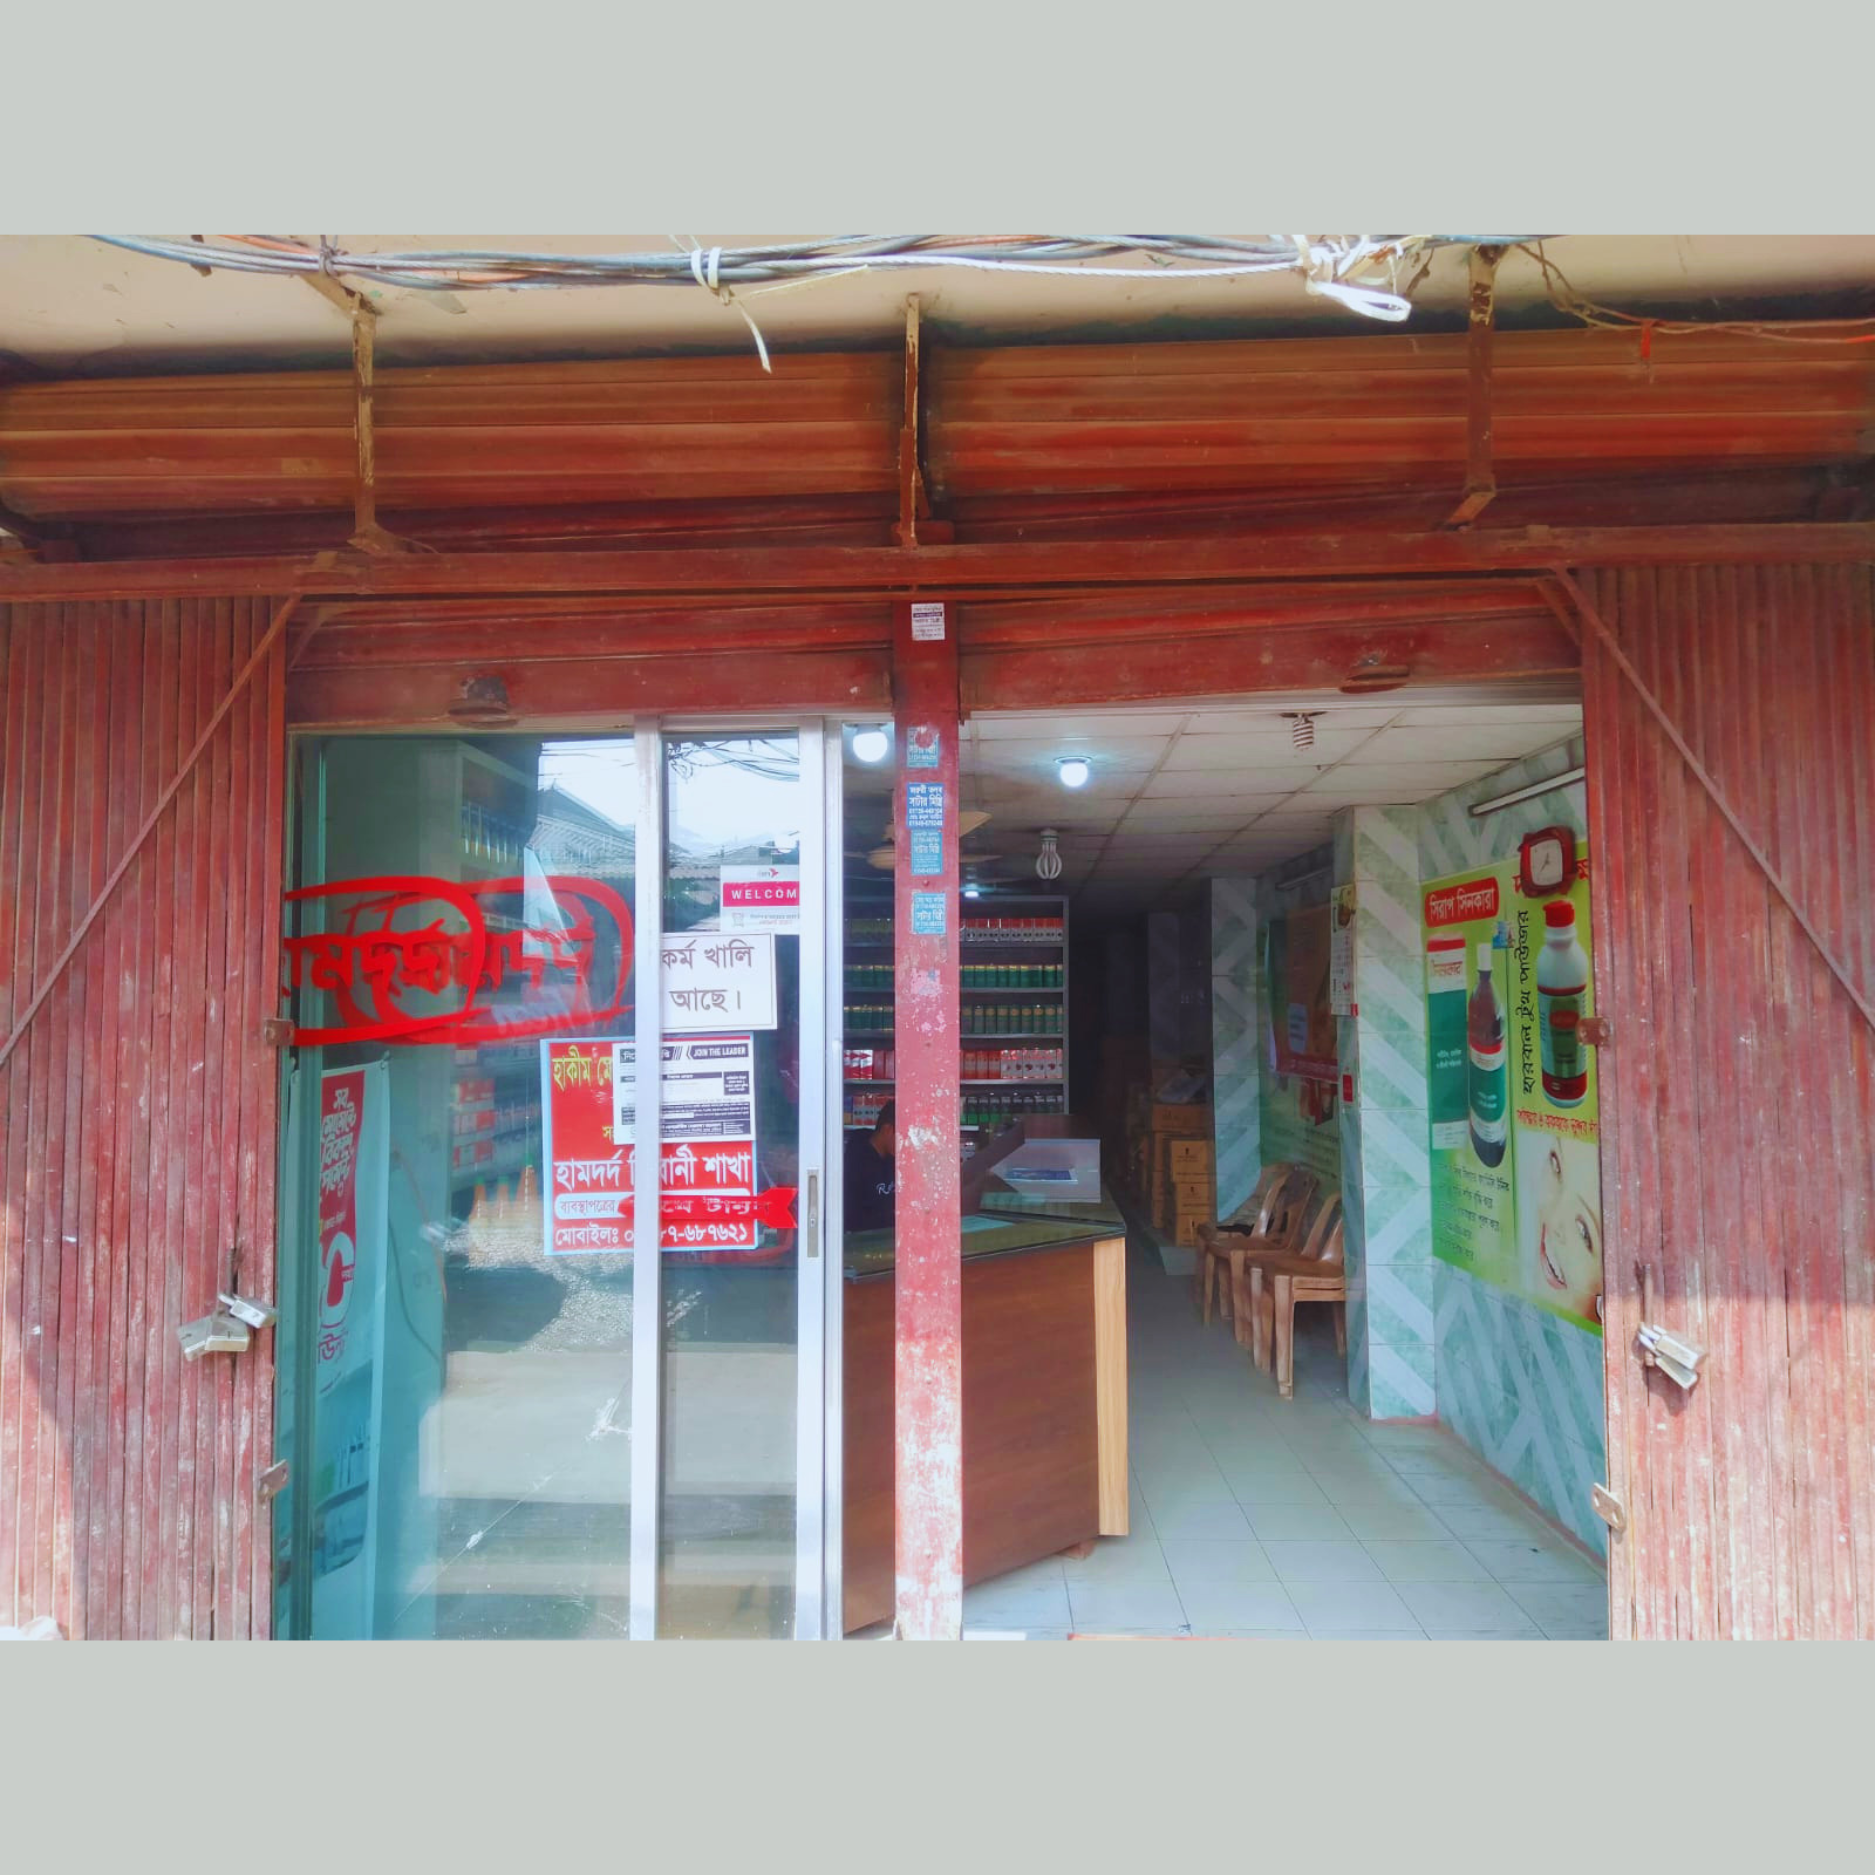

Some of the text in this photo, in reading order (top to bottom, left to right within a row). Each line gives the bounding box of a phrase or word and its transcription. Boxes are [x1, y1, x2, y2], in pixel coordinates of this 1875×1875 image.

[731, 888, 797, 900] WELCOM
[1429, 887, 1496, 920] সিরাপ সিনকারা
[704, 938, 755, 968] খালি
[1514, 909, 1530, 985] পাউডার
[668, 986, 728, 1013] আছে
[1515, 989, 1535, 1022] টুথ
[693, 1045, 746, 1057] JOIN THE LEADER
[1520, 1024, 1536, 1095] হারবাল
[551, 1045, 592, 1092] হাকীম
[553, 1149, 623, 1191] হামদর্দ
[702, 1152, 751, 1184] শাখা
